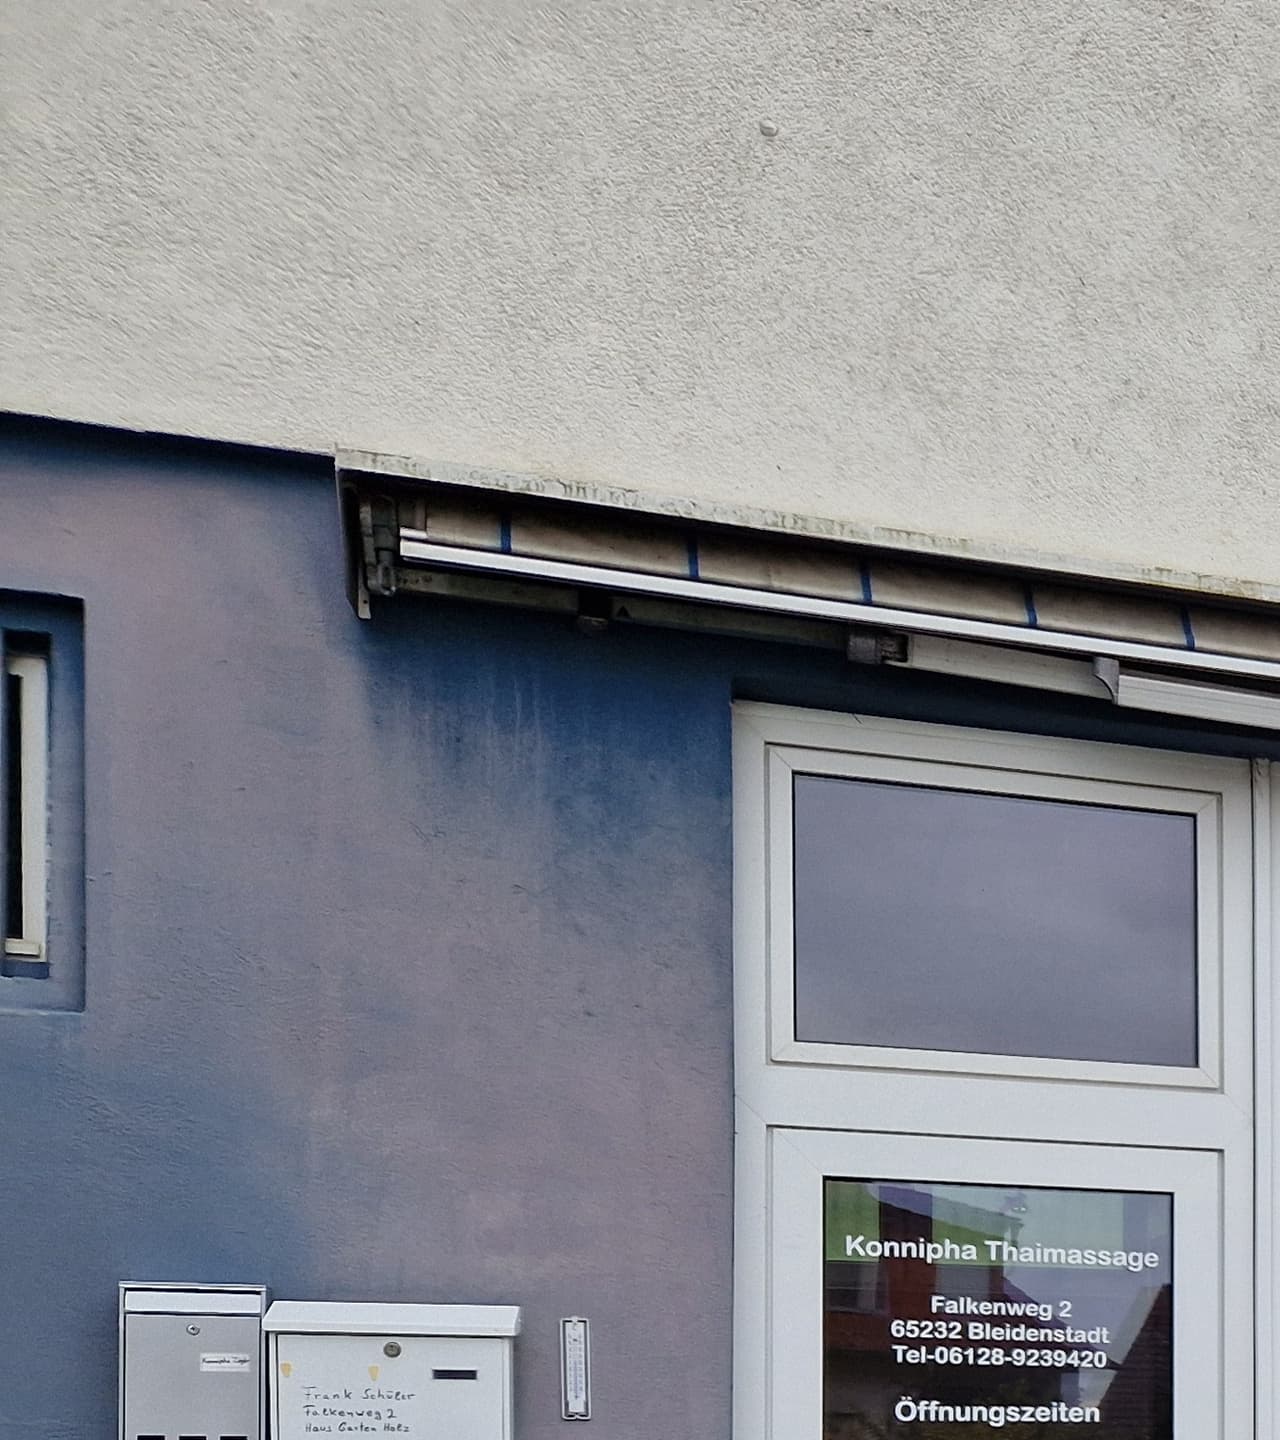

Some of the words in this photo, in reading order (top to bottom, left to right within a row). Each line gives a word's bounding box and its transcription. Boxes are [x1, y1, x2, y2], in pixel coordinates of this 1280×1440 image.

[845, 1235, 978, 1264] Konnipha
[984, 1239, 1160, 1272] Thaimassage
[931, 1295, 1052, 1320] Falkenweg
[1058, 1300, 1073, 1318] 2
[890, 1319, 962, 1339] 65232
[968, 1322, 1111, 1344] Bleidenstadt
[892, 1345, 1107, 1368] Tel-06128-9239420
[303, 1386, 352, 1400] Frank
[387, 1409, 397, 1418] 2
[894, 1396, 1100, 1427] Öffnungszeiten
